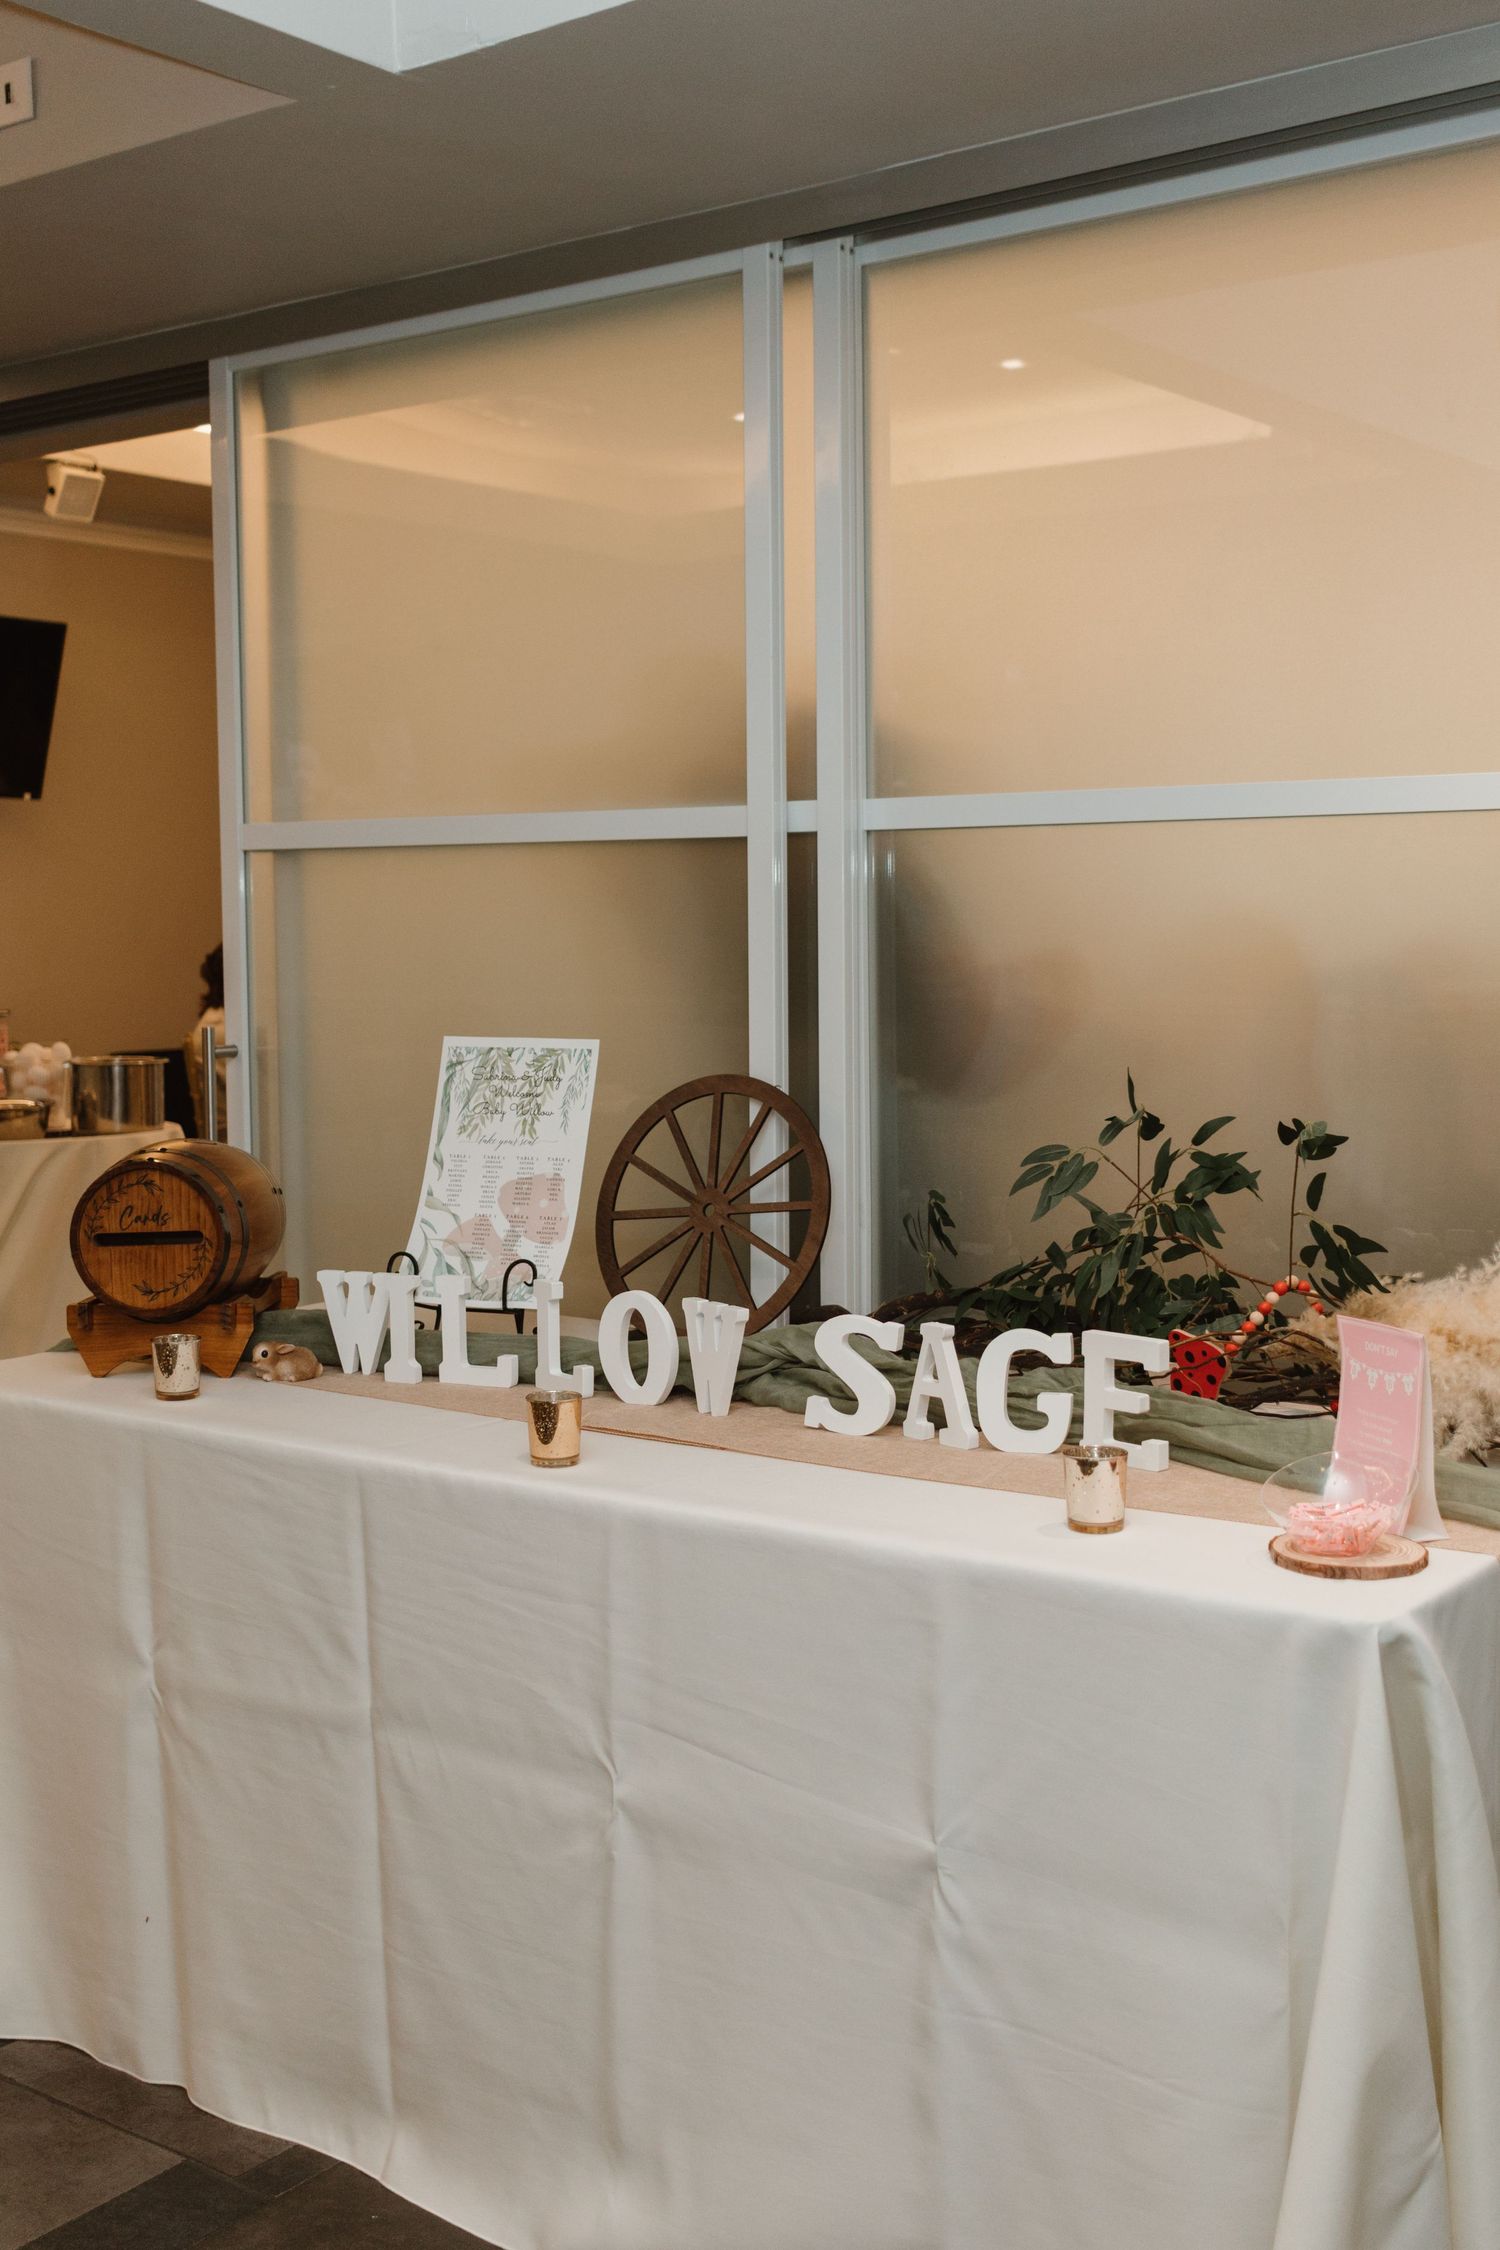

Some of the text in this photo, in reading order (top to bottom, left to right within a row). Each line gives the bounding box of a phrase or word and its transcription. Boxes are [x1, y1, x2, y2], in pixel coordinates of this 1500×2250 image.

[472, 1063, 563, 1091] Sabrina & Judy
[488, 1084, 544, 1099] Welcome
[472, 1101, 555, 1122] Baby Willow
[120, 1205, 171, 1231] Cards
[316, 1269, 1171, 1472] WILLOW SAGE
